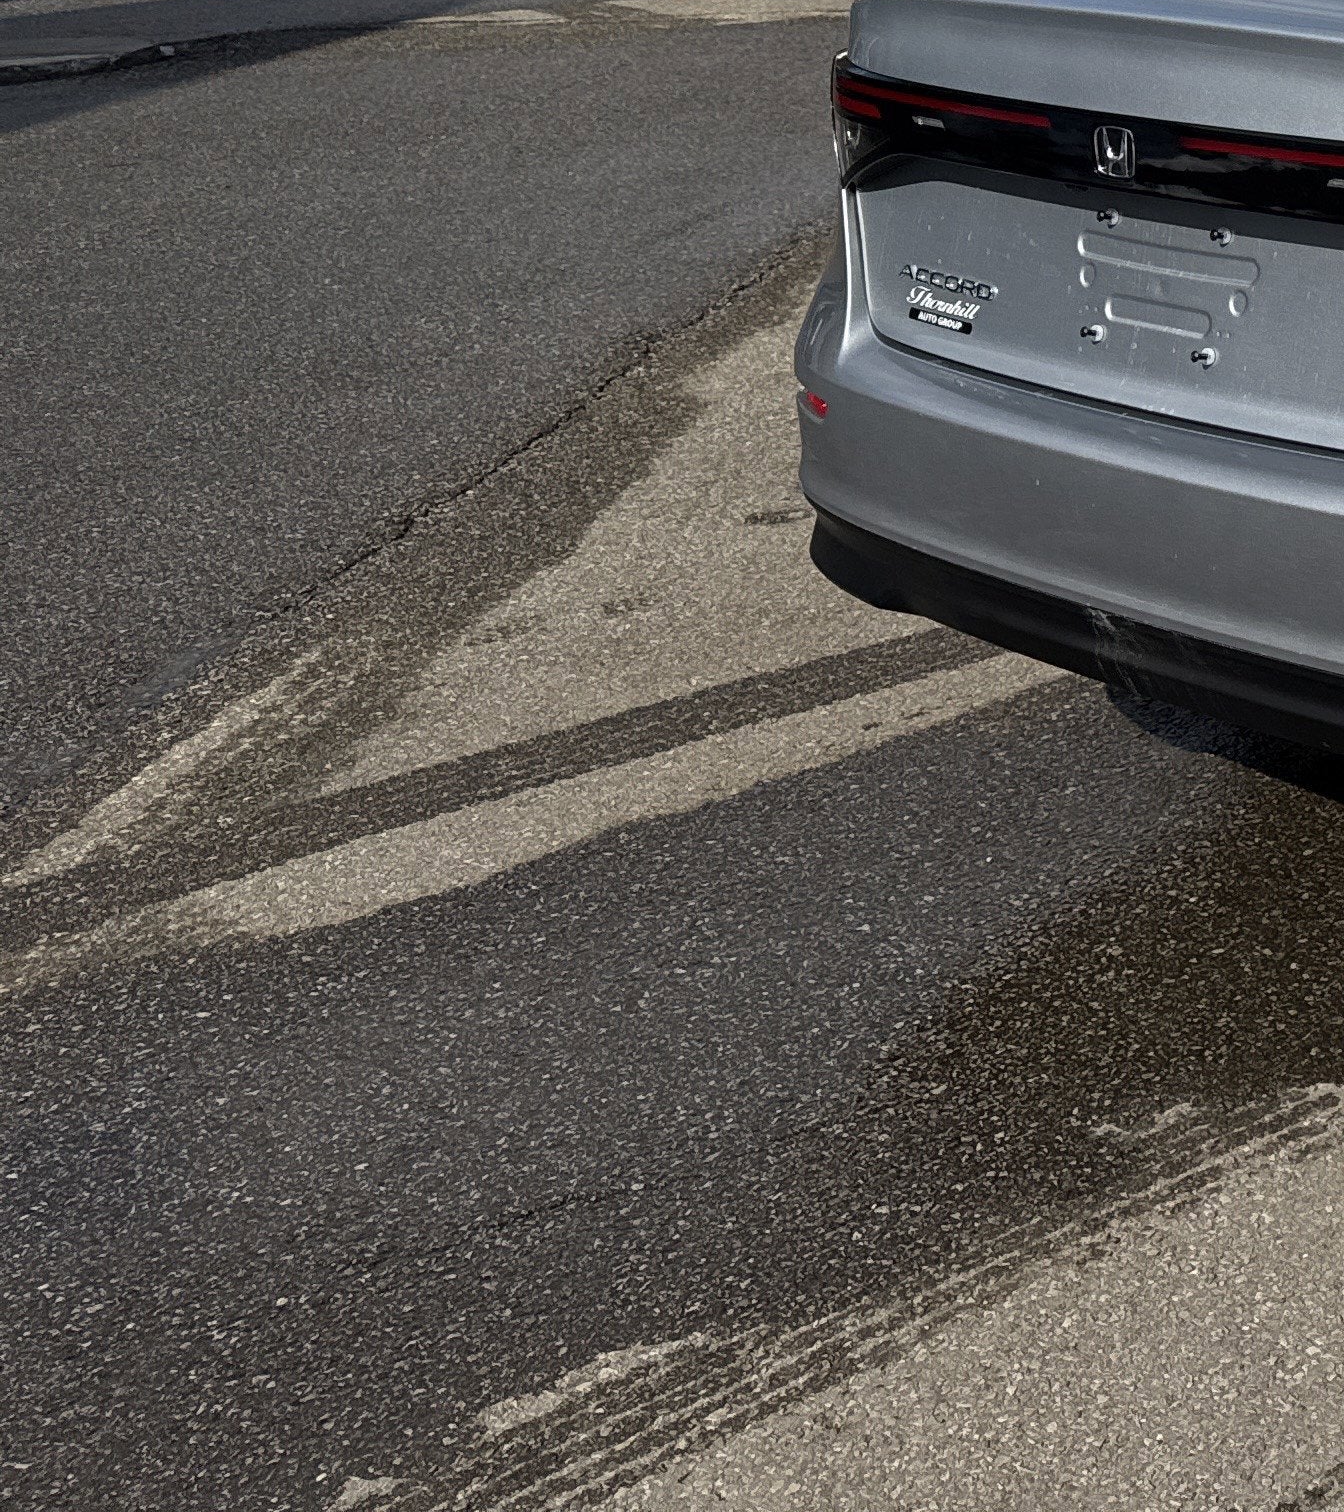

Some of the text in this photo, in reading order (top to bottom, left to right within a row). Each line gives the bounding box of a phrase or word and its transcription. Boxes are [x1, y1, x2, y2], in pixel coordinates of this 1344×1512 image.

[899, 264, 994, 301] ACCORD
[906, 285, 980, 320] Thornhill
[918, 311, 963, 331] AUTO GROUP
